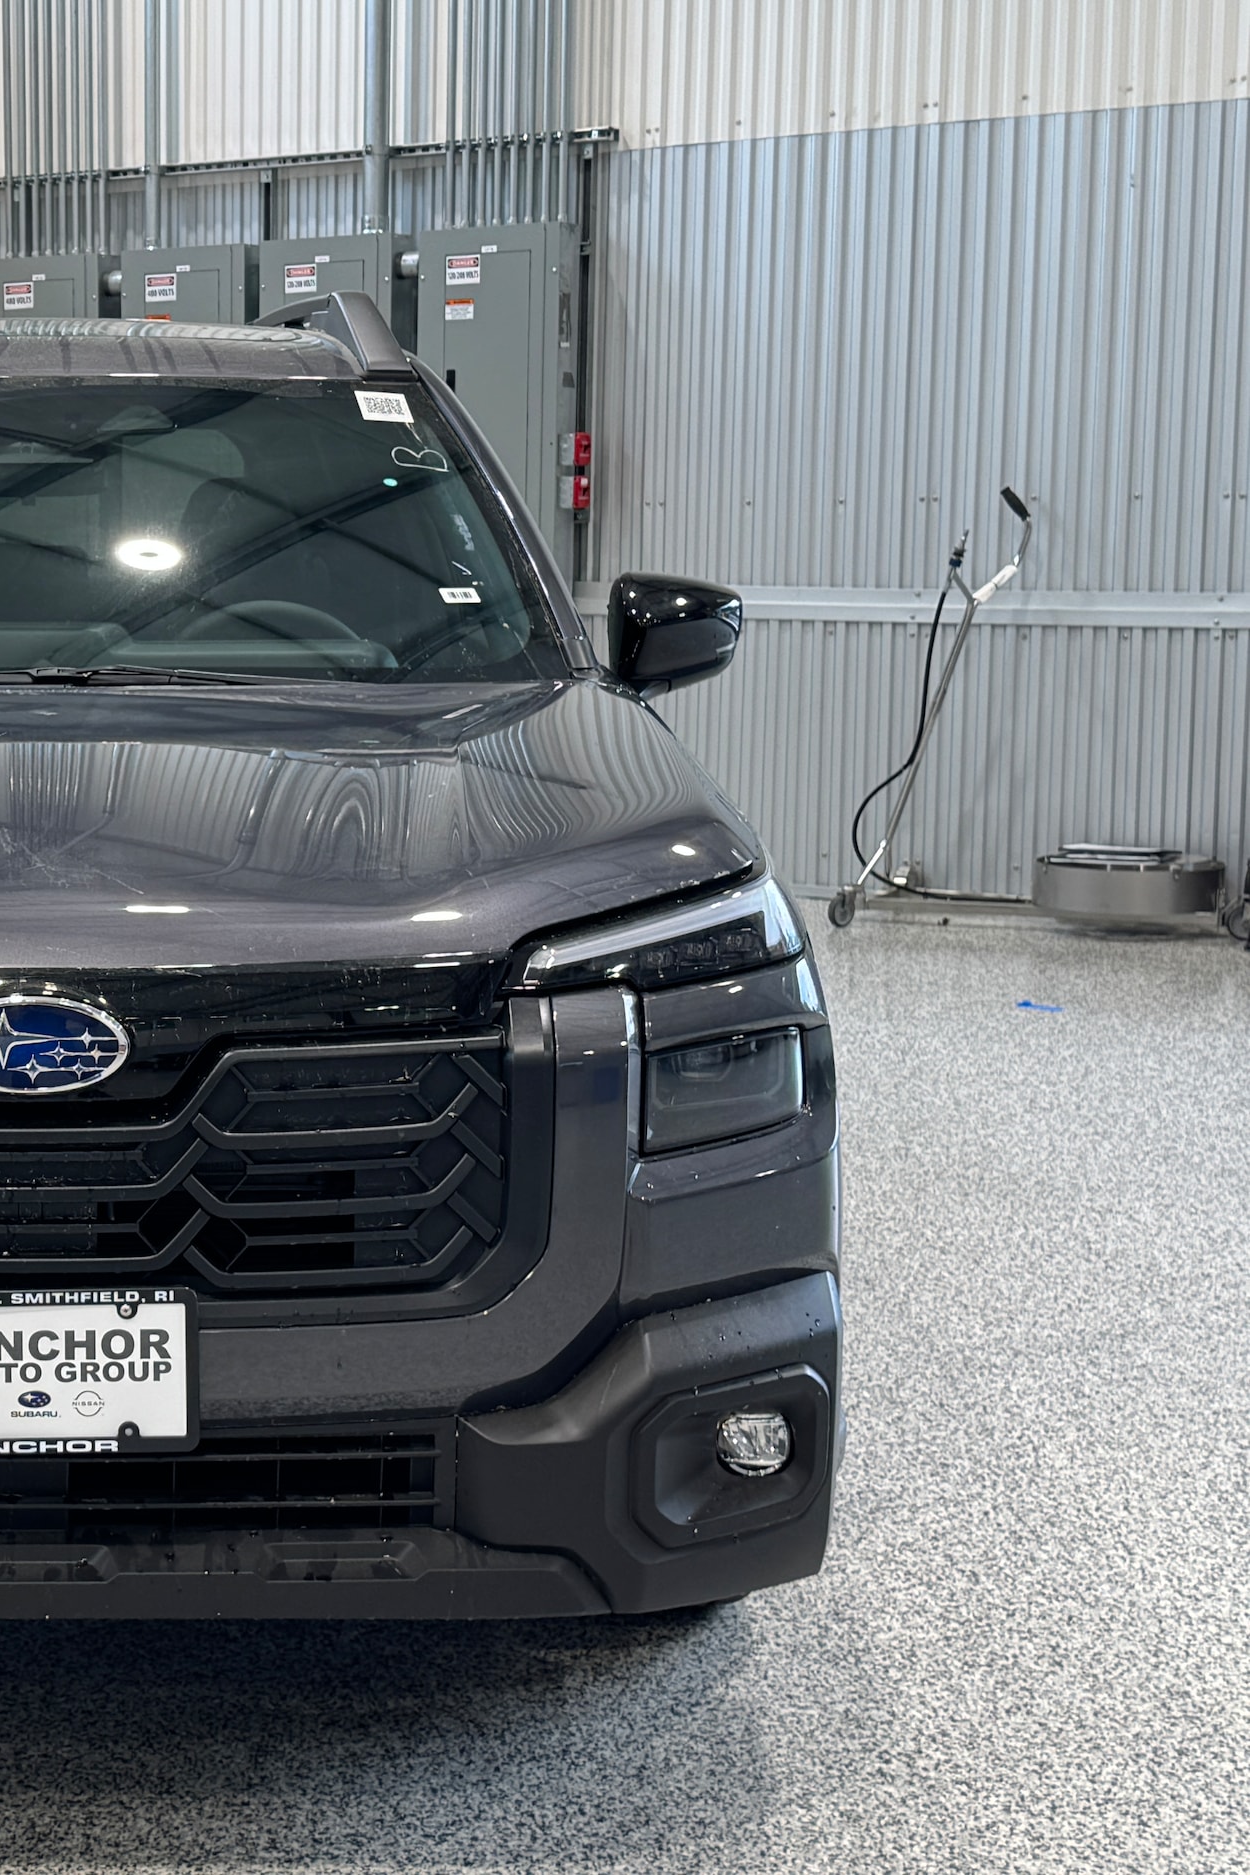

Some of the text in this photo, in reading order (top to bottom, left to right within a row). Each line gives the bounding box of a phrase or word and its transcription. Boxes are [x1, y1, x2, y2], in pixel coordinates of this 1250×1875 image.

[11, 1290, 147, 1305] SMITHFIELD,
[155, 1289, 175, 1303] RI
[54, 1361, 173, 1383] GROUP
[10, 1410, 58, 1418] SUBARU
